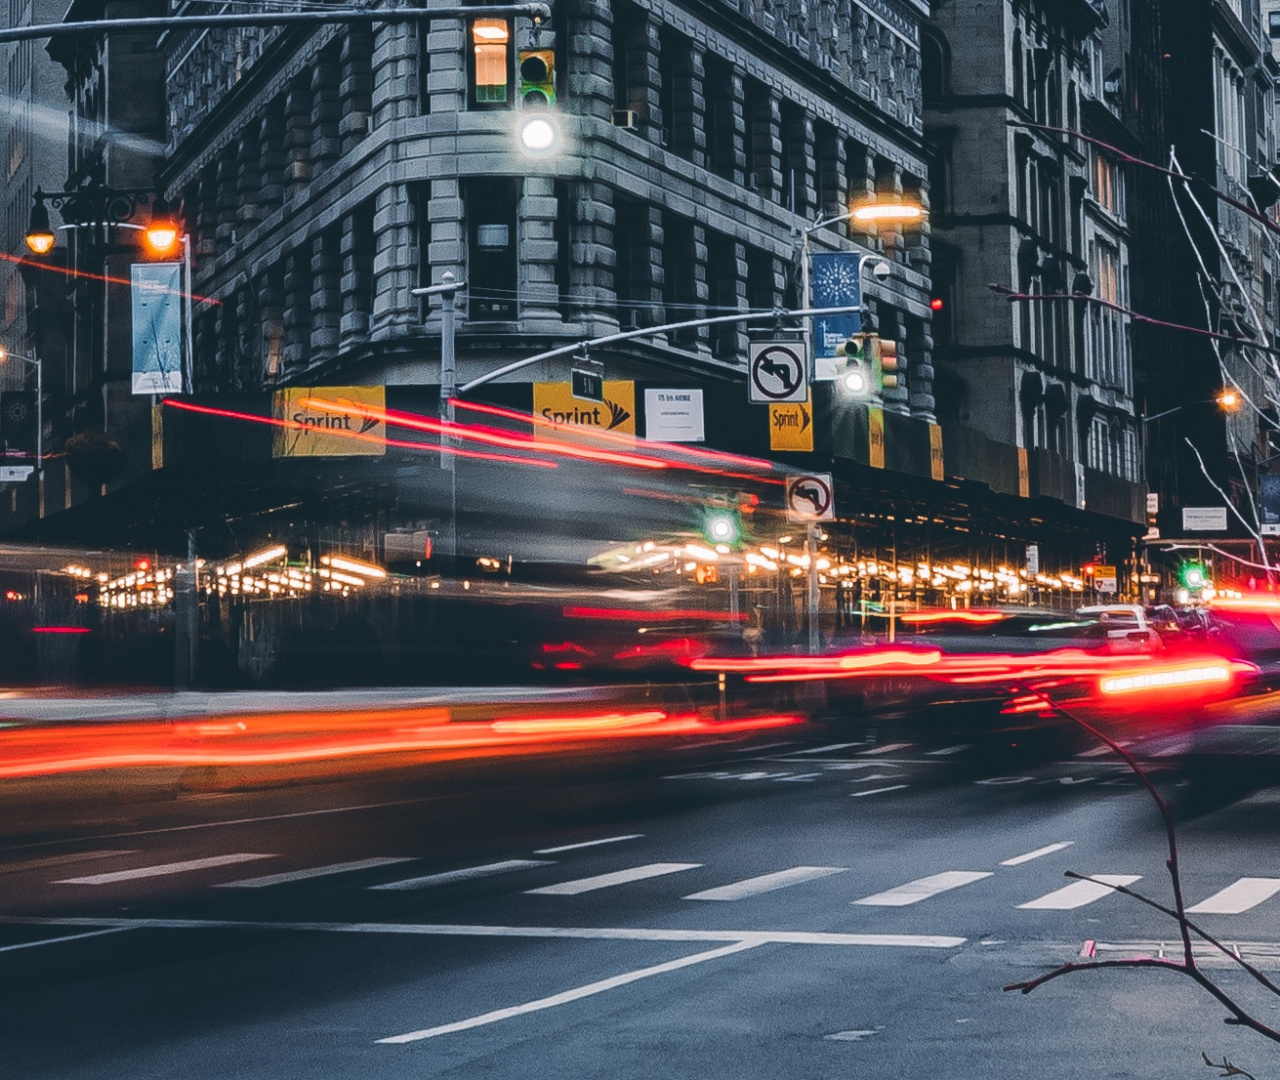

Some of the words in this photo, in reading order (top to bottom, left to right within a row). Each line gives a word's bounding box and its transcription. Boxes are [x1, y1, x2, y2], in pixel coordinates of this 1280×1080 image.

[293, 412, 351, 433] Sprint
[541, 406, 601, 429] Sprint
[773, 410, 799, 431] Sprint
